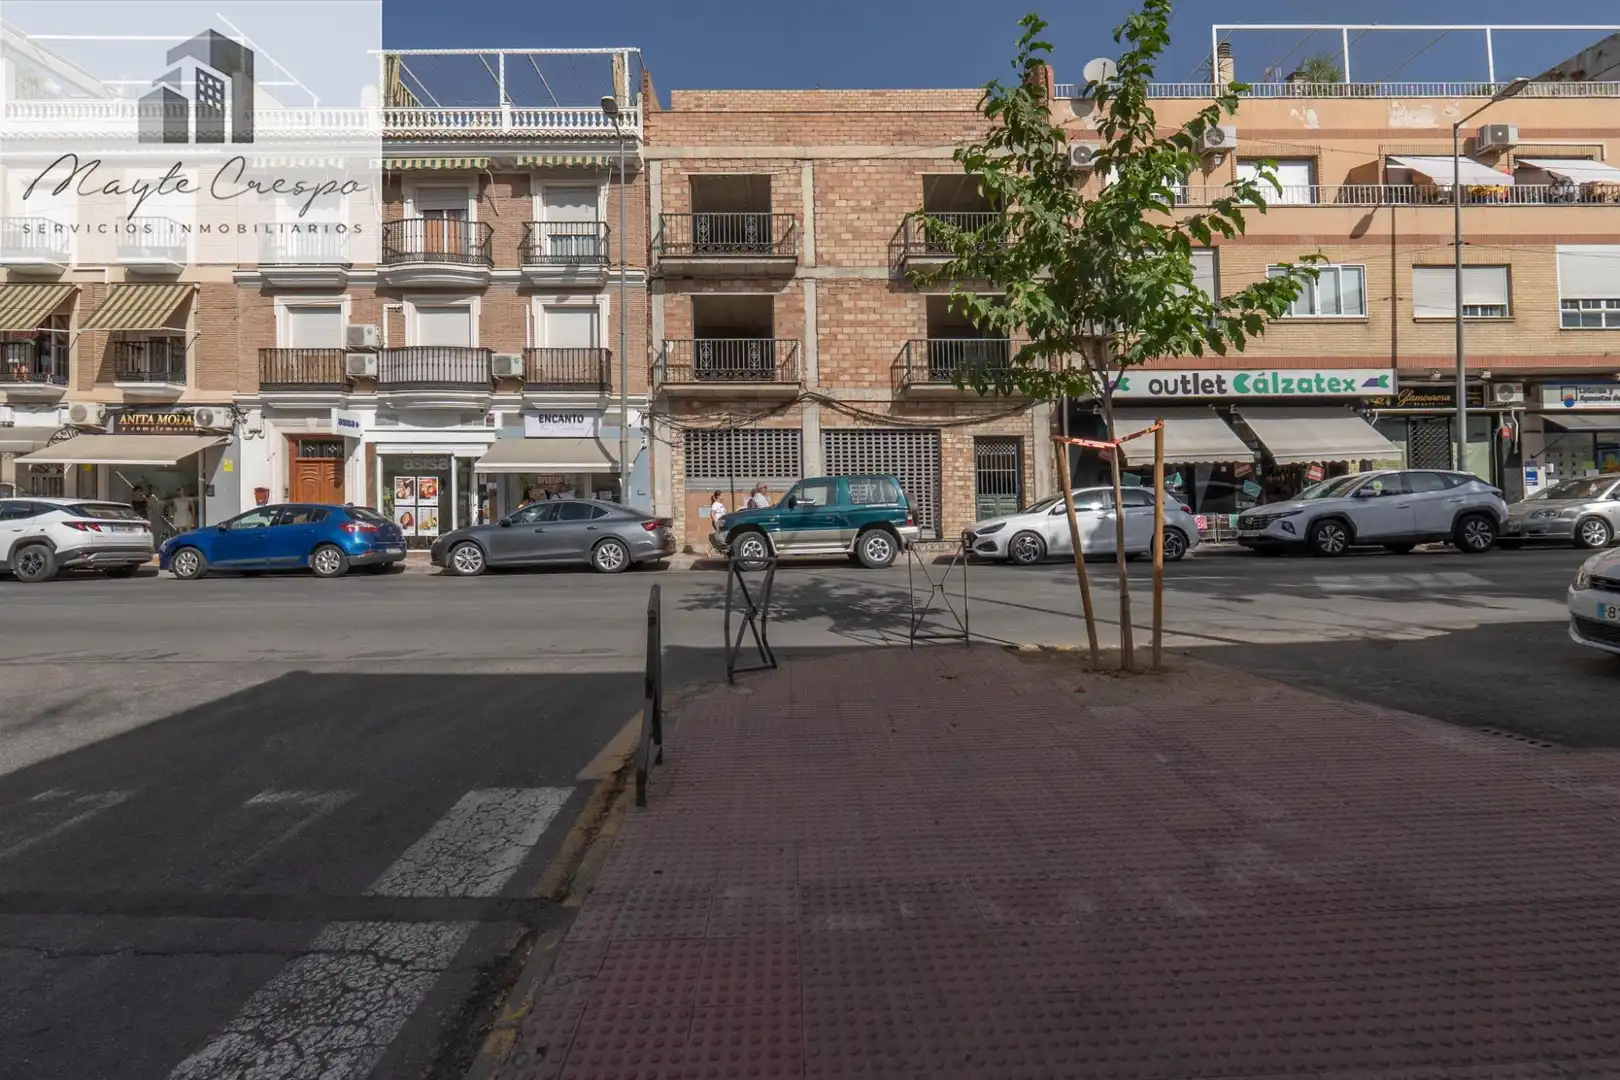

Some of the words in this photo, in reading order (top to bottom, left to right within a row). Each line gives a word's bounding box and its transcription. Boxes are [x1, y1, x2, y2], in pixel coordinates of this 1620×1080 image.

[1149, 372, 1228, 395] outlet
[1233, 371, 1357, 394] Cálzatex
[1397, 388, 1452, 407] Glamourosa
[118, 414, 155, 425] ANITA
[156, 414, 194, 426] MODA
[538, 413, 584, 424] ENCANTO
[403, 456, 450, 471] asisa
